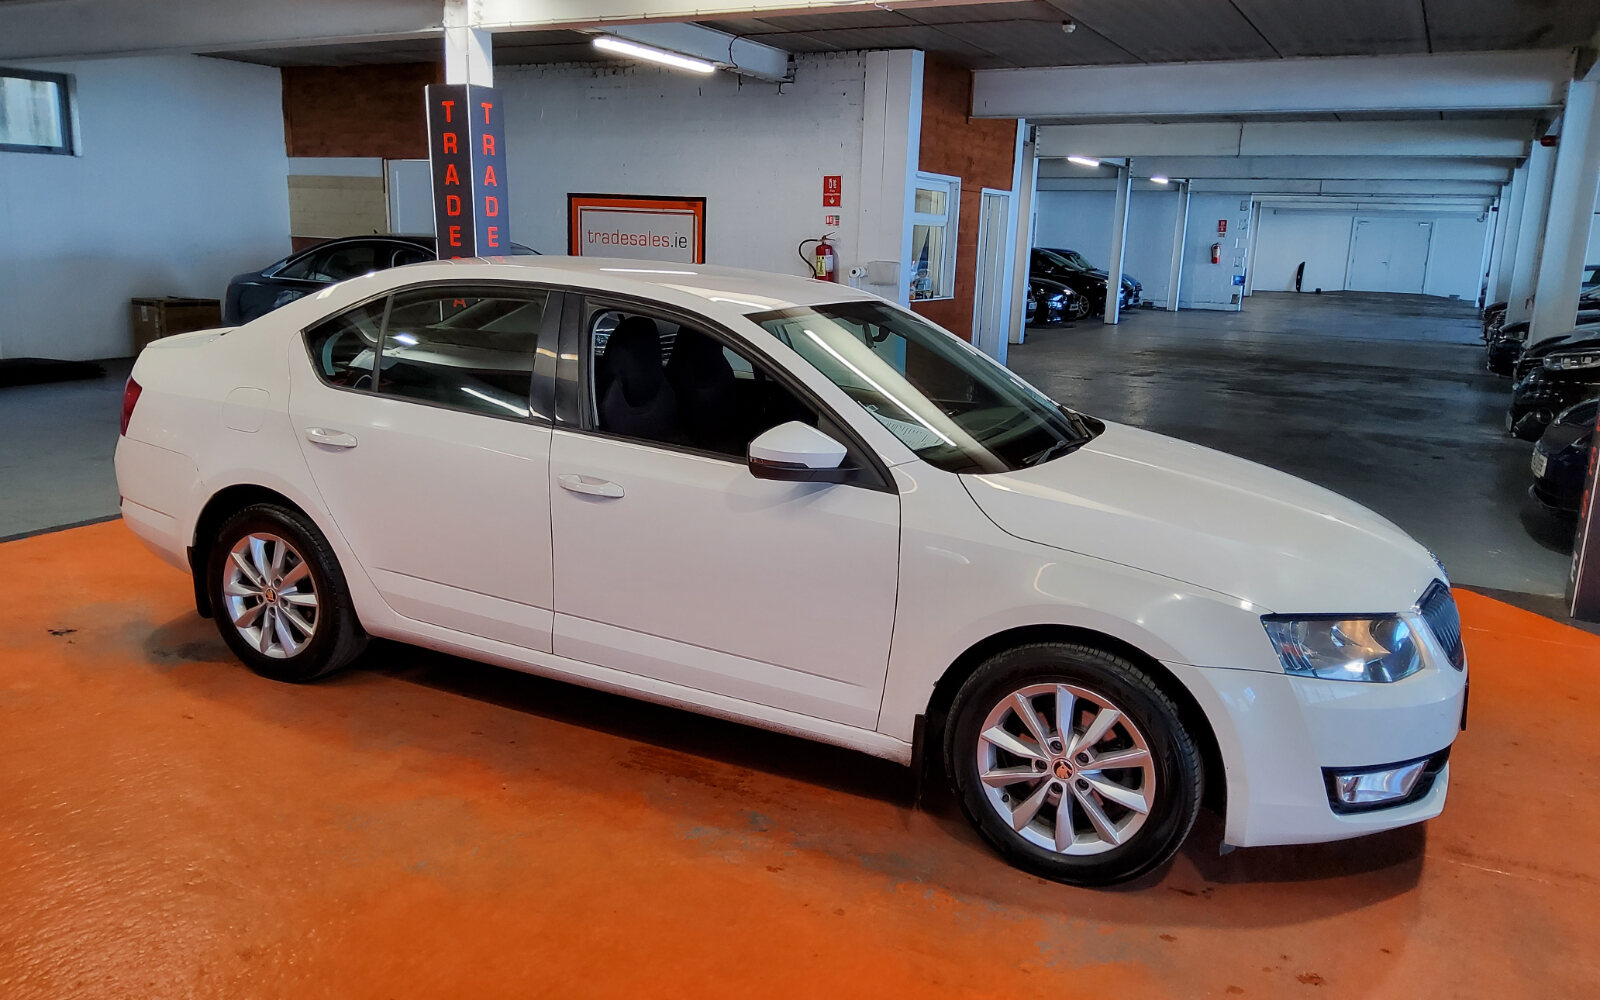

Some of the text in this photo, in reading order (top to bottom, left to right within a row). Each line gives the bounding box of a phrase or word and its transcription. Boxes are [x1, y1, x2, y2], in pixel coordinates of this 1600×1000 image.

[441, 100, 462, 247] TRADE
[481, 102, 499, 248] TRADE
[587, 229, 688, 249] tradesales.ie
